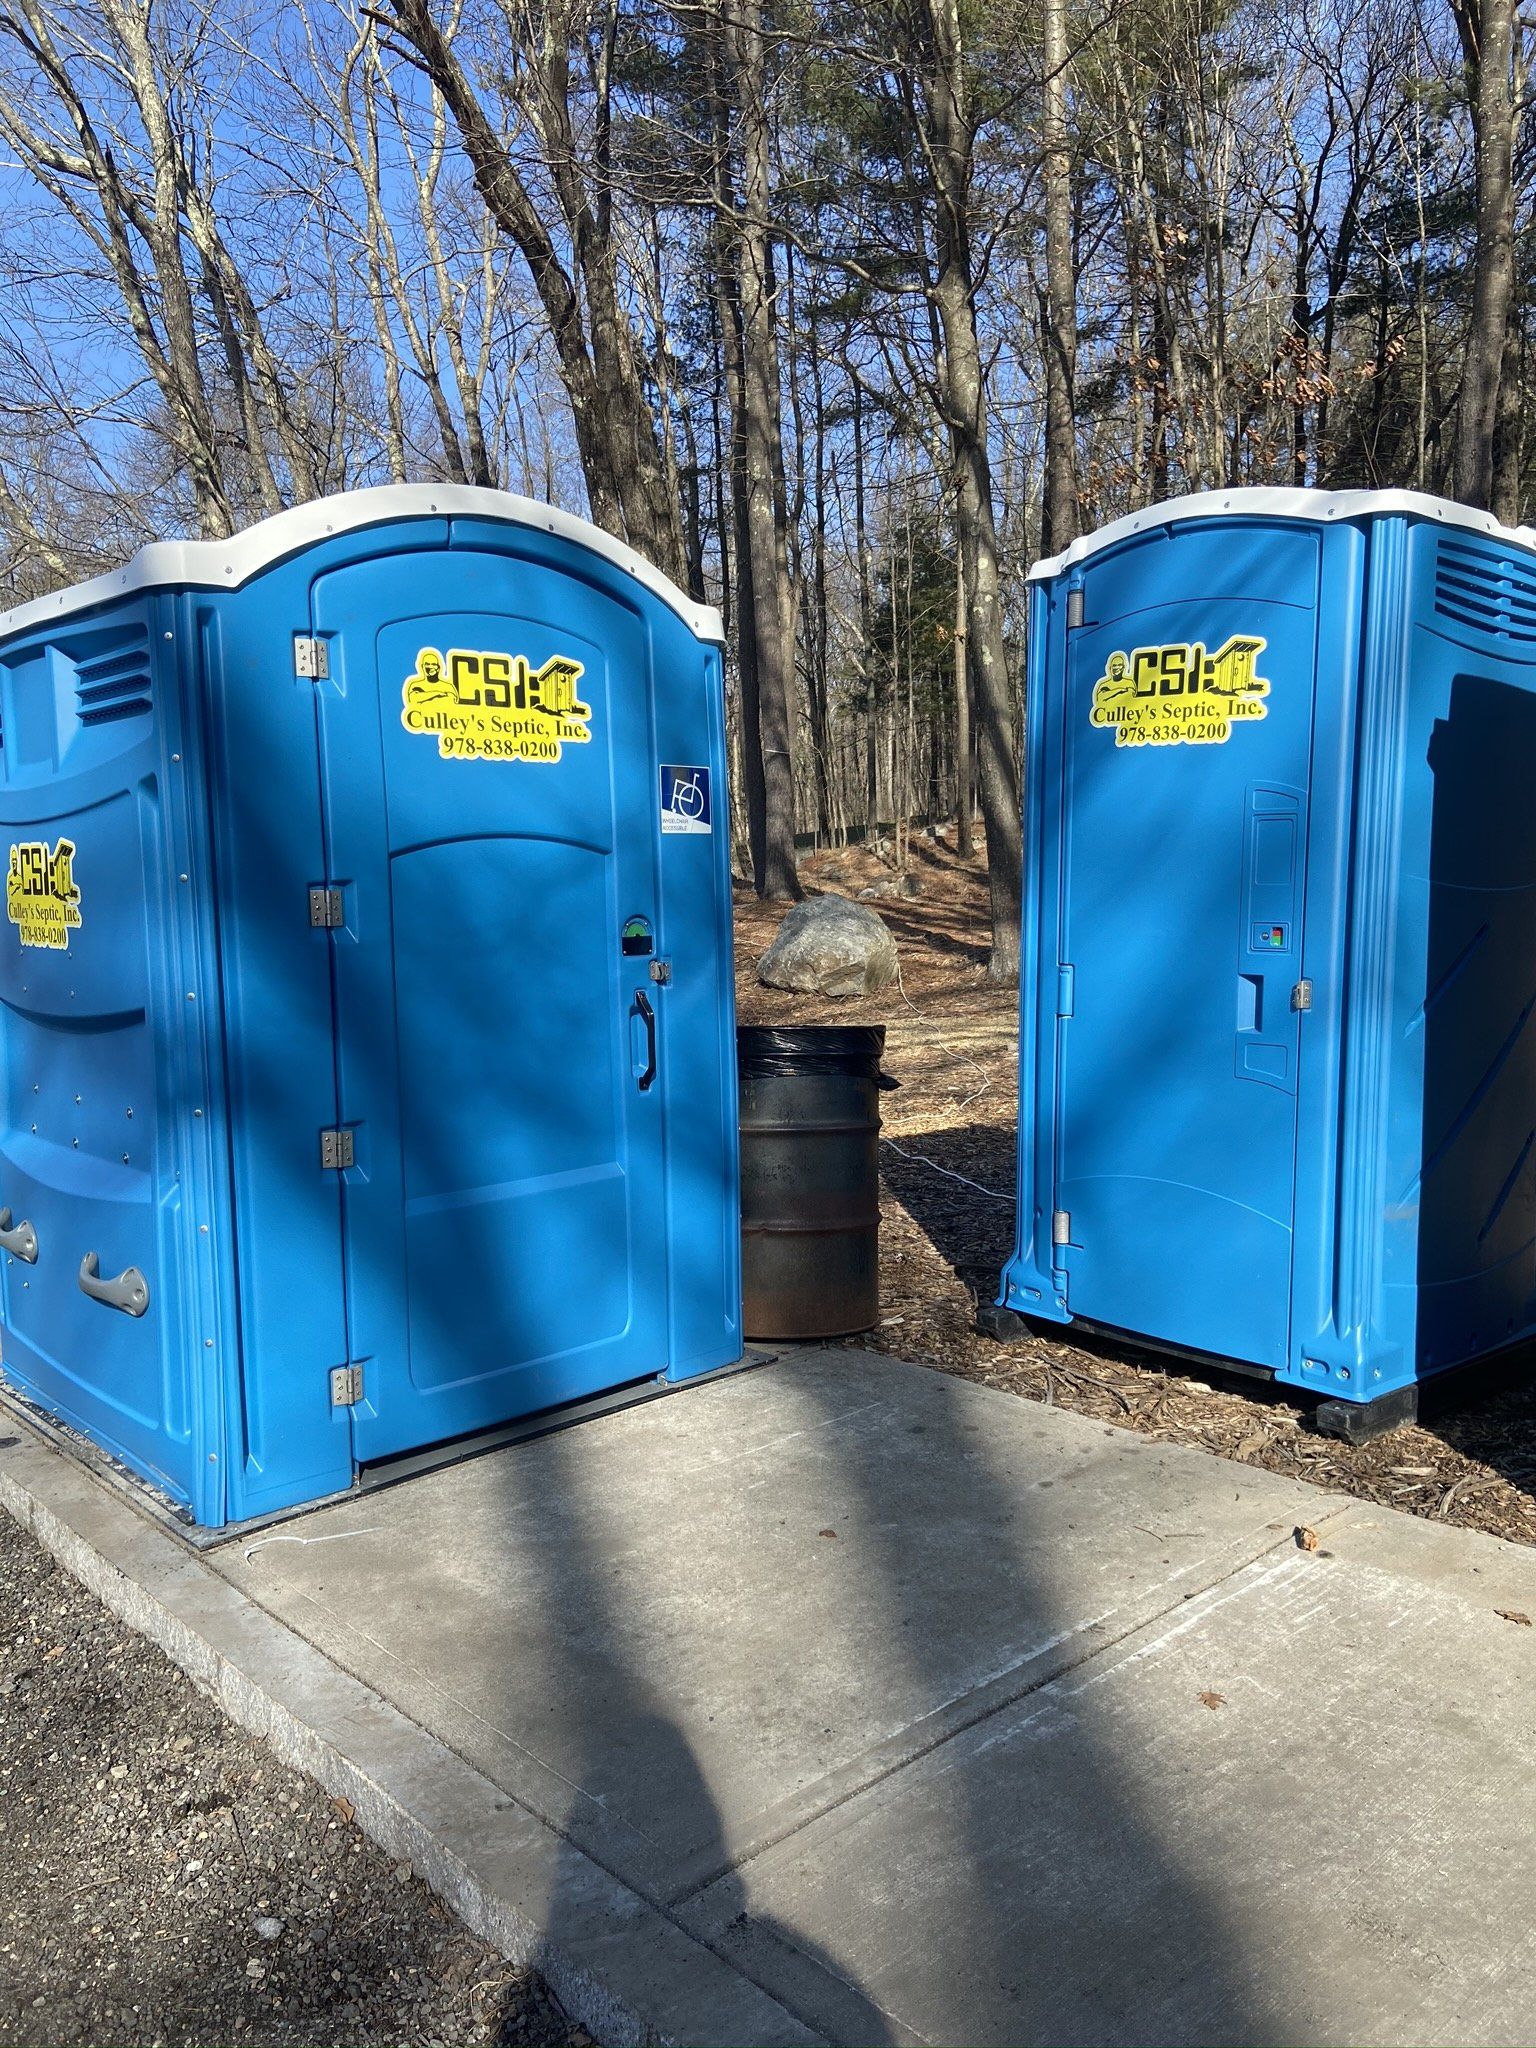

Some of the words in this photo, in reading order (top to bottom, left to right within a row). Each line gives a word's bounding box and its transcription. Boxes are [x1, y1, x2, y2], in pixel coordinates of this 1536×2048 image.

[1093, 704, 1157, 725] Culley's
[1162, 701, 1220, 722] Septic,
[1227, 699, 1263, 716] Inc.
[406, 710, 485, 735] Culley's
[491, 715, 550, 739] Septic,
[555, 720, 587, 738] Inc.
[1119, 722, 1227, 742] 978-838-0200
[443, 736, 558, 758] 978-838-0200
[8, 902, 35, 923] Culley's
[63, 905, 80, 922] Inc.
[21, 925, 67, 944] 978-838-0200
